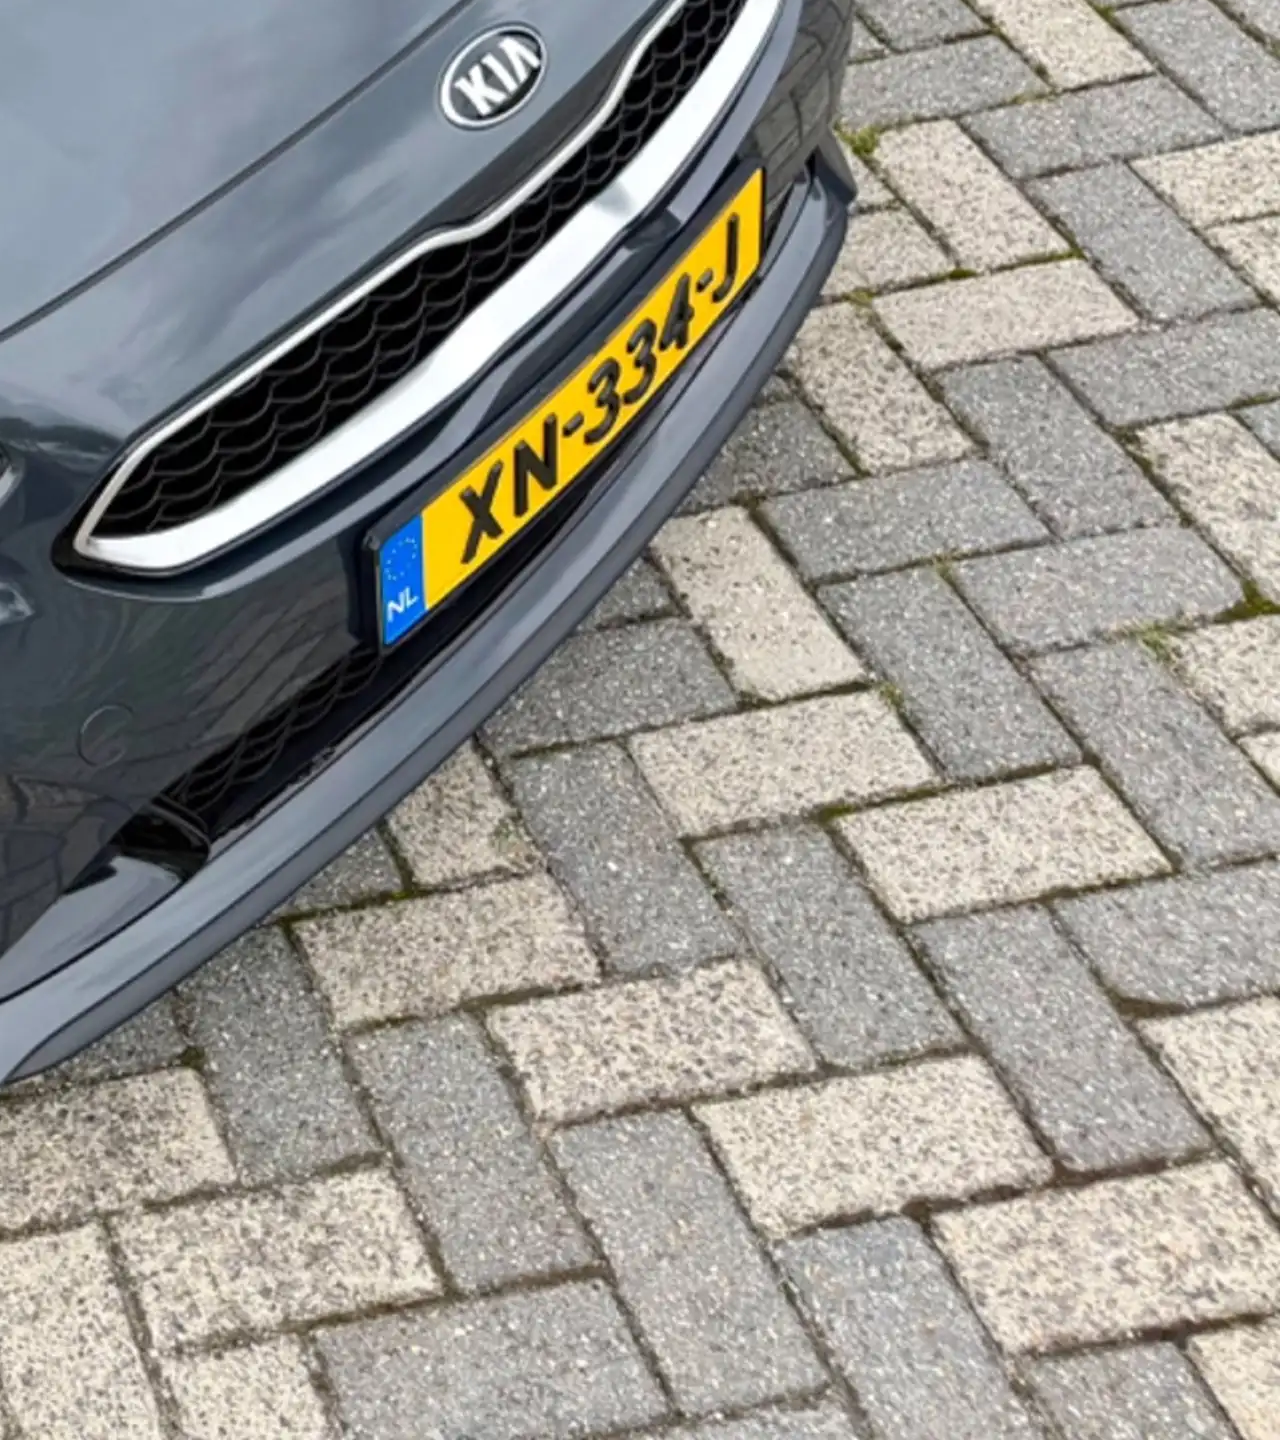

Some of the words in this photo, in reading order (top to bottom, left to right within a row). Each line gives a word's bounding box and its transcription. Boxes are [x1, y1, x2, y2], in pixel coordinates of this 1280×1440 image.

[453, 36, 540, 116] KIA
[459, 211, 741, 565] XN-334-J
[386, 585, 420, 624] NL
